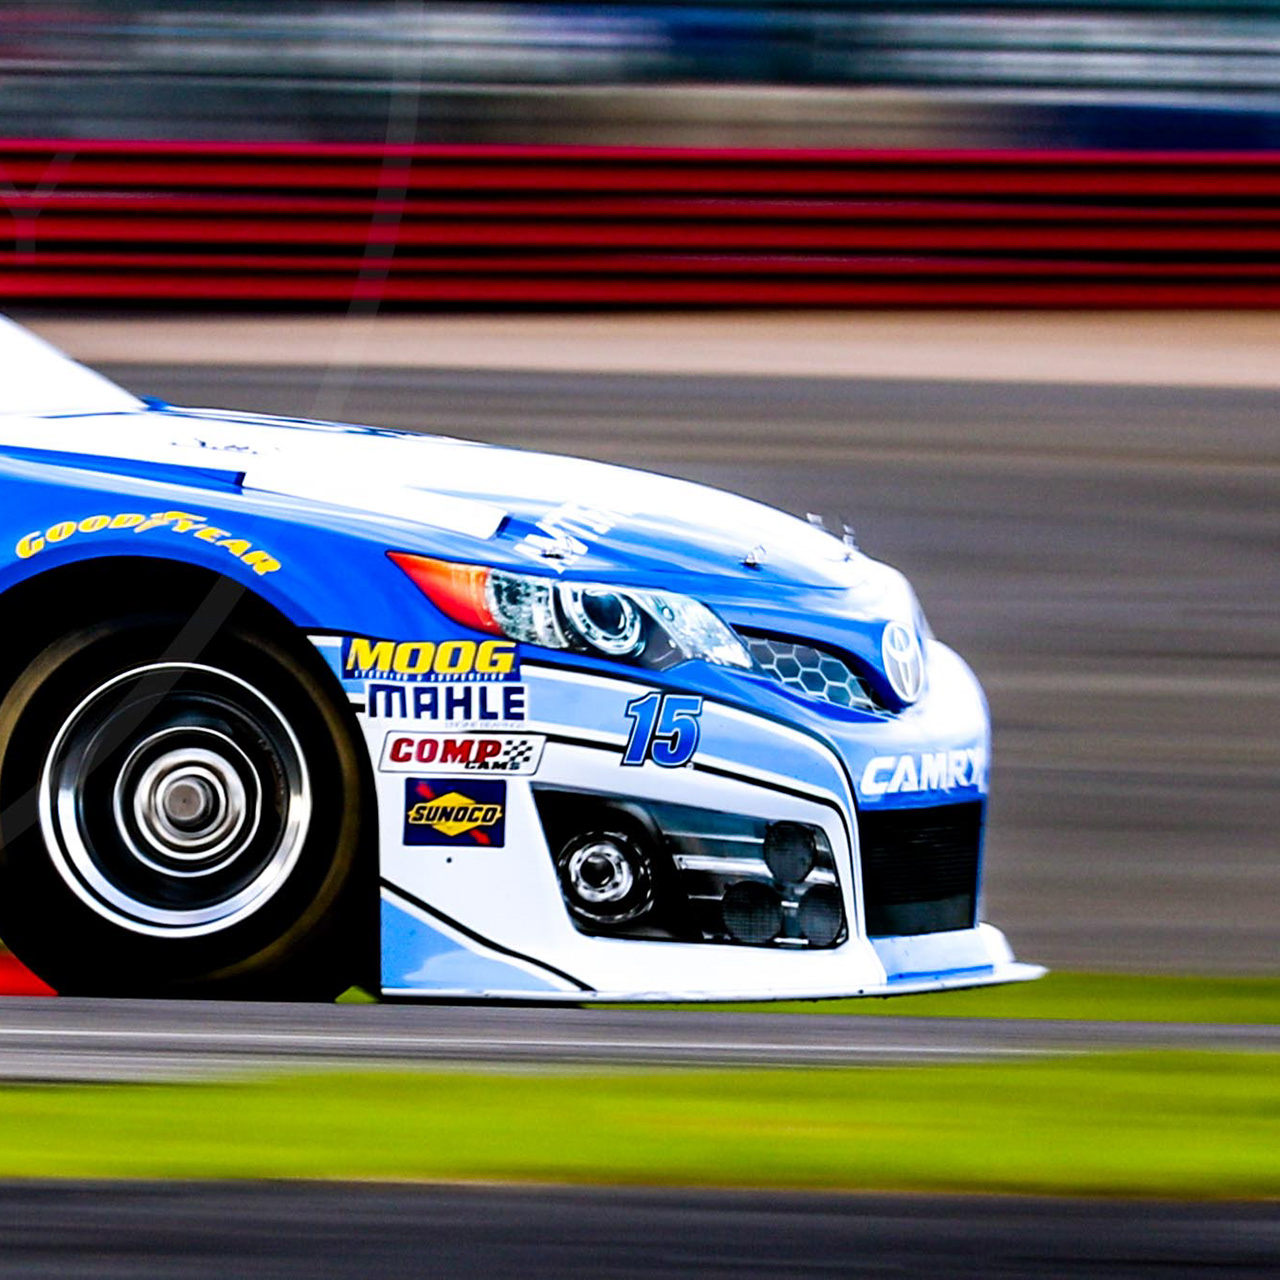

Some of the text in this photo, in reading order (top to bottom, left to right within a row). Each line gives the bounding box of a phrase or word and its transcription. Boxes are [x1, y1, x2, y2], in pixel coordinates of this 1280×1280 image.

[15, 511, 281, 575] GOODYEAR
[346, 638, 517, 675] MOOG
[368, 683, 525, 721] MAHLE
[618, 690, 705, 769] 15
[389, 738, 503, 763] COMP
[465, 761, 521, 771] CAMS
[860, 748, 990, 796] CAMRY
[411, 806, 499, 824] SUNOCO
